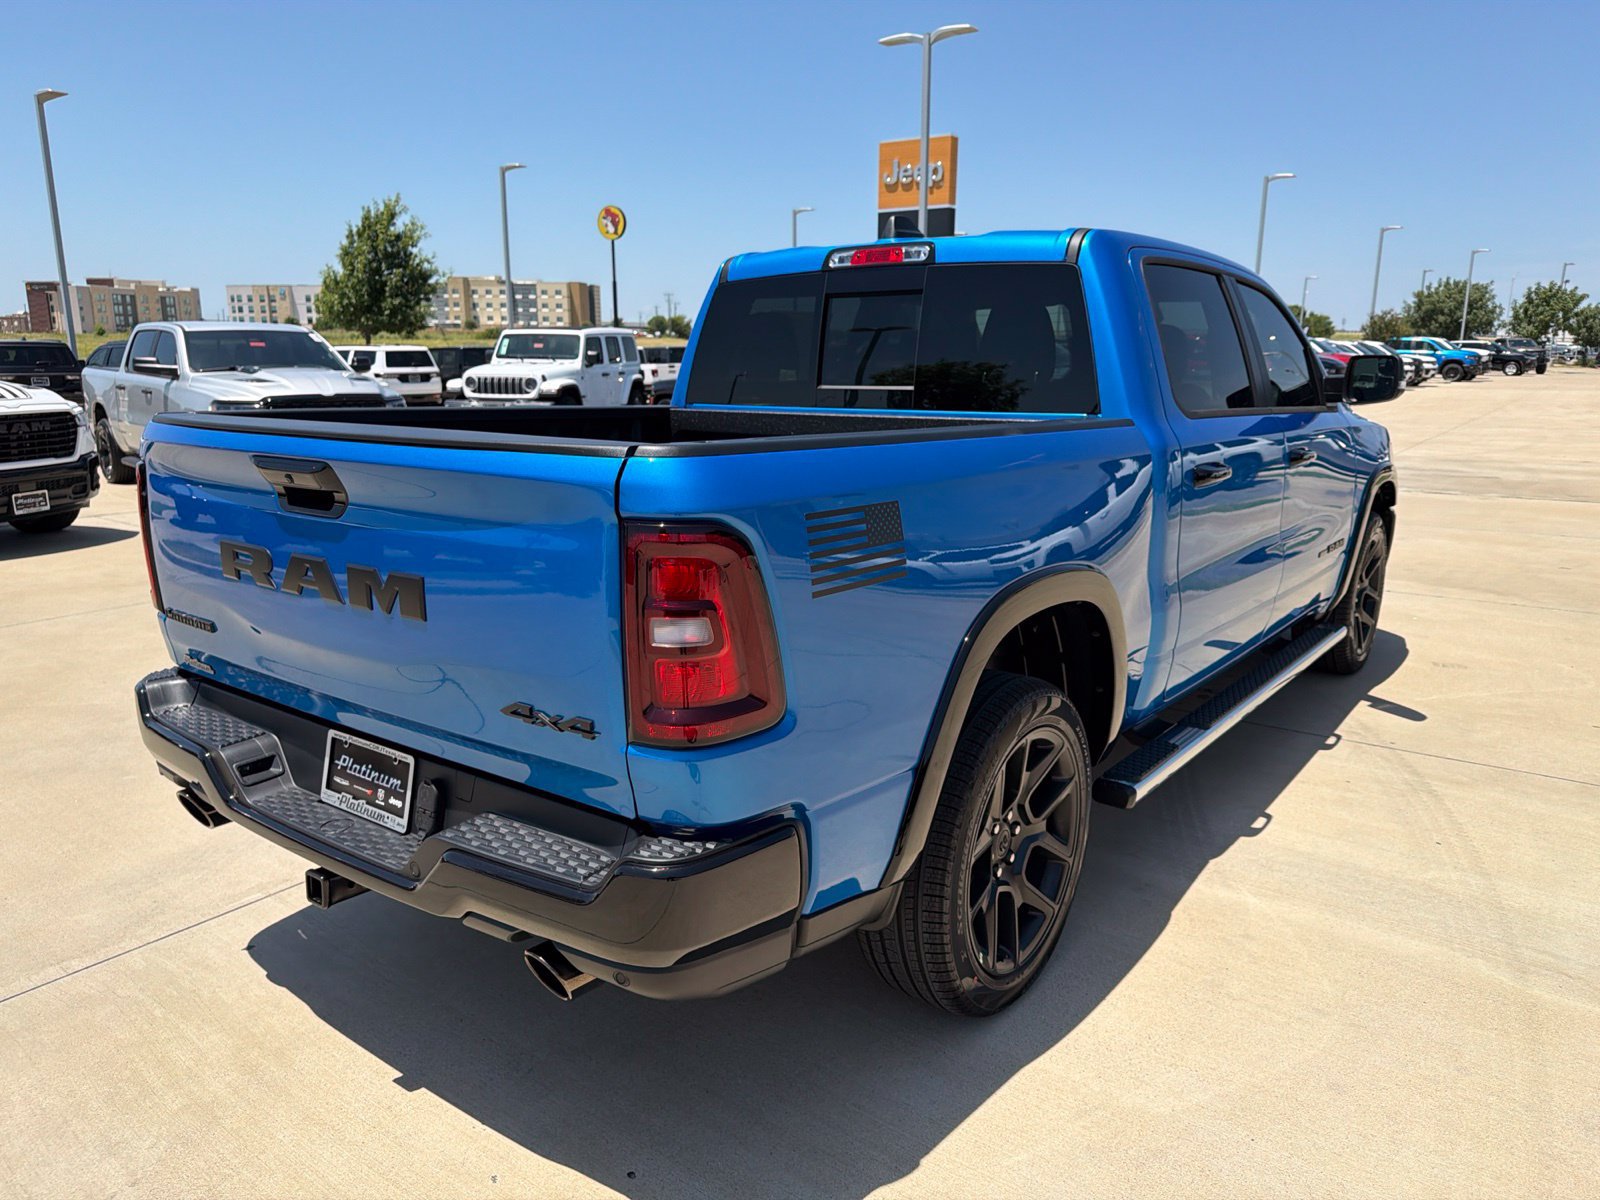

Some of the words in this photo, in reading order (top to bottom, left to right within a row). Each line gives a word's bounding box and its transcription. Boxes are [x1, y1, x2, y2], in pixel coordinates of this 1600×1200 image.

[220, 540, 427, 622] RAM
[334, 755, 404, 793] Platinum
[339, 793, 389, 823] Platinum
